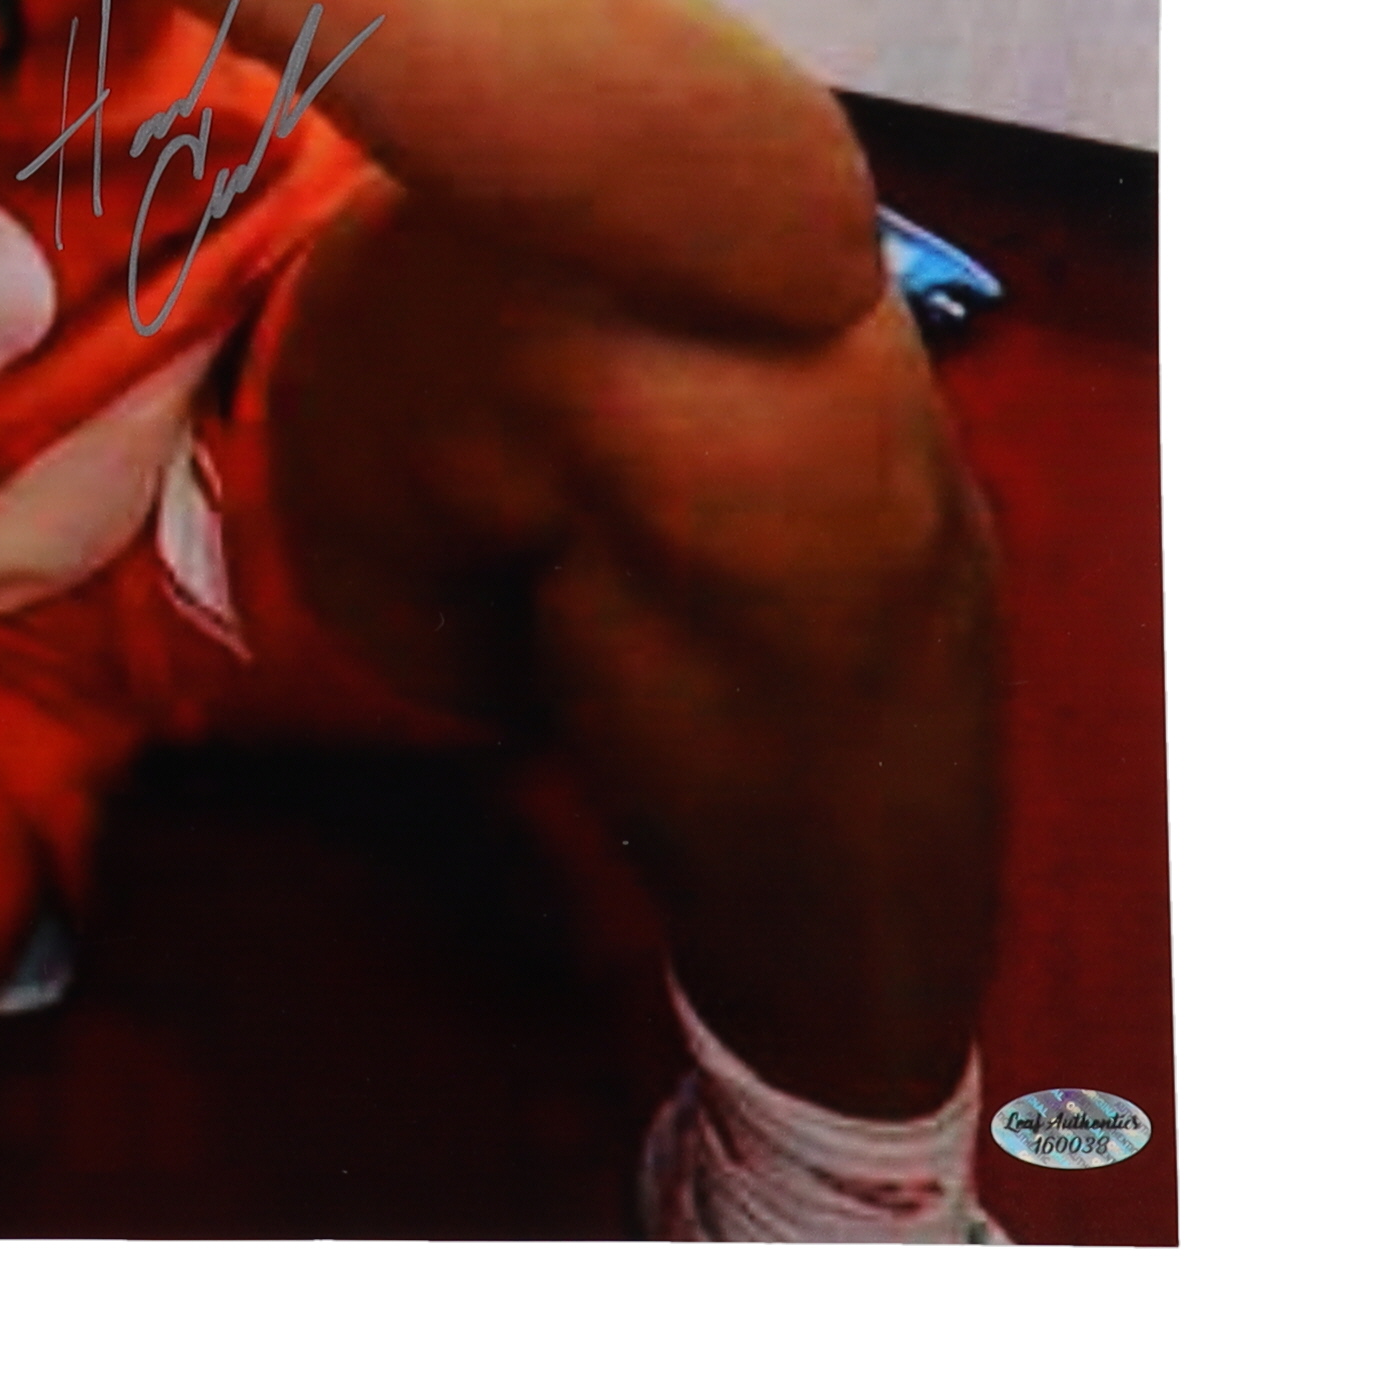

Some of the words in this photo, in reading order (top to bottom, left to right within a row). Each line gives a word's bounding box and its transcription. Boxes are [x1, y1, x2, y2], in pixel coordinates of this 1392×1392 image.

[1004, 1111, 1045, 1134] Leaf
[1046, 1111, 1141, 1130] Authentics
[1034, 1135, 1110, 1156] 160038
